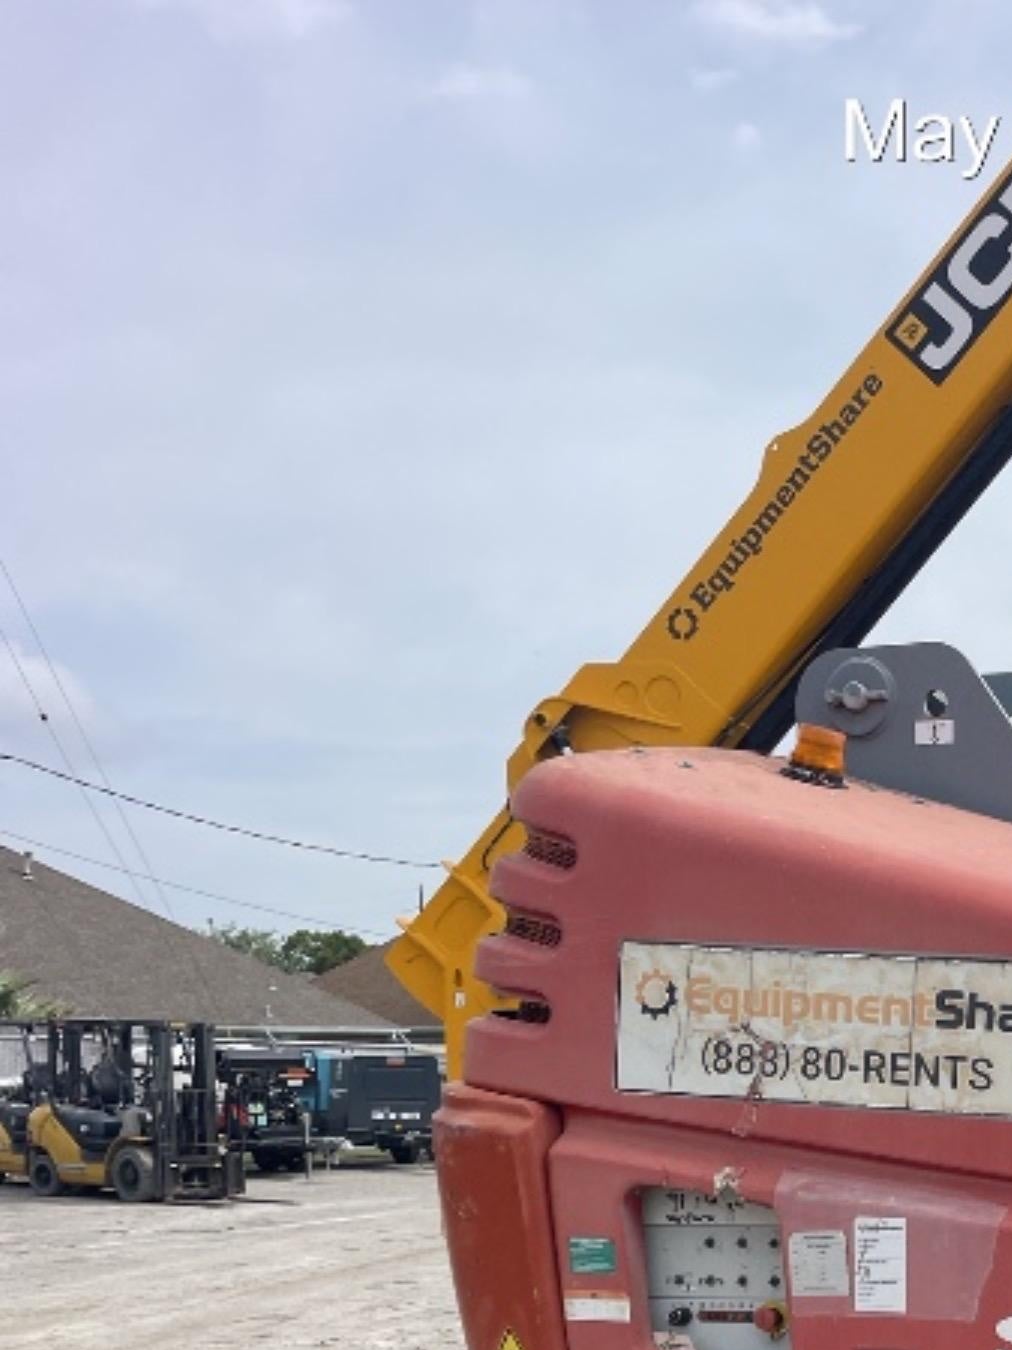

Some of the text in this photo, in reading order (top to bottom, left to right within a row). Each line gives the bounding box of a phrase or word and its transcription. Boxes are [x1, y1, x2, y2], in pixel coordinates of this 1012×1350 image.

[689, 373, 884, 612] EquipmentShare
[701, 1036, 995, 1091] (888) 80-RENTS
